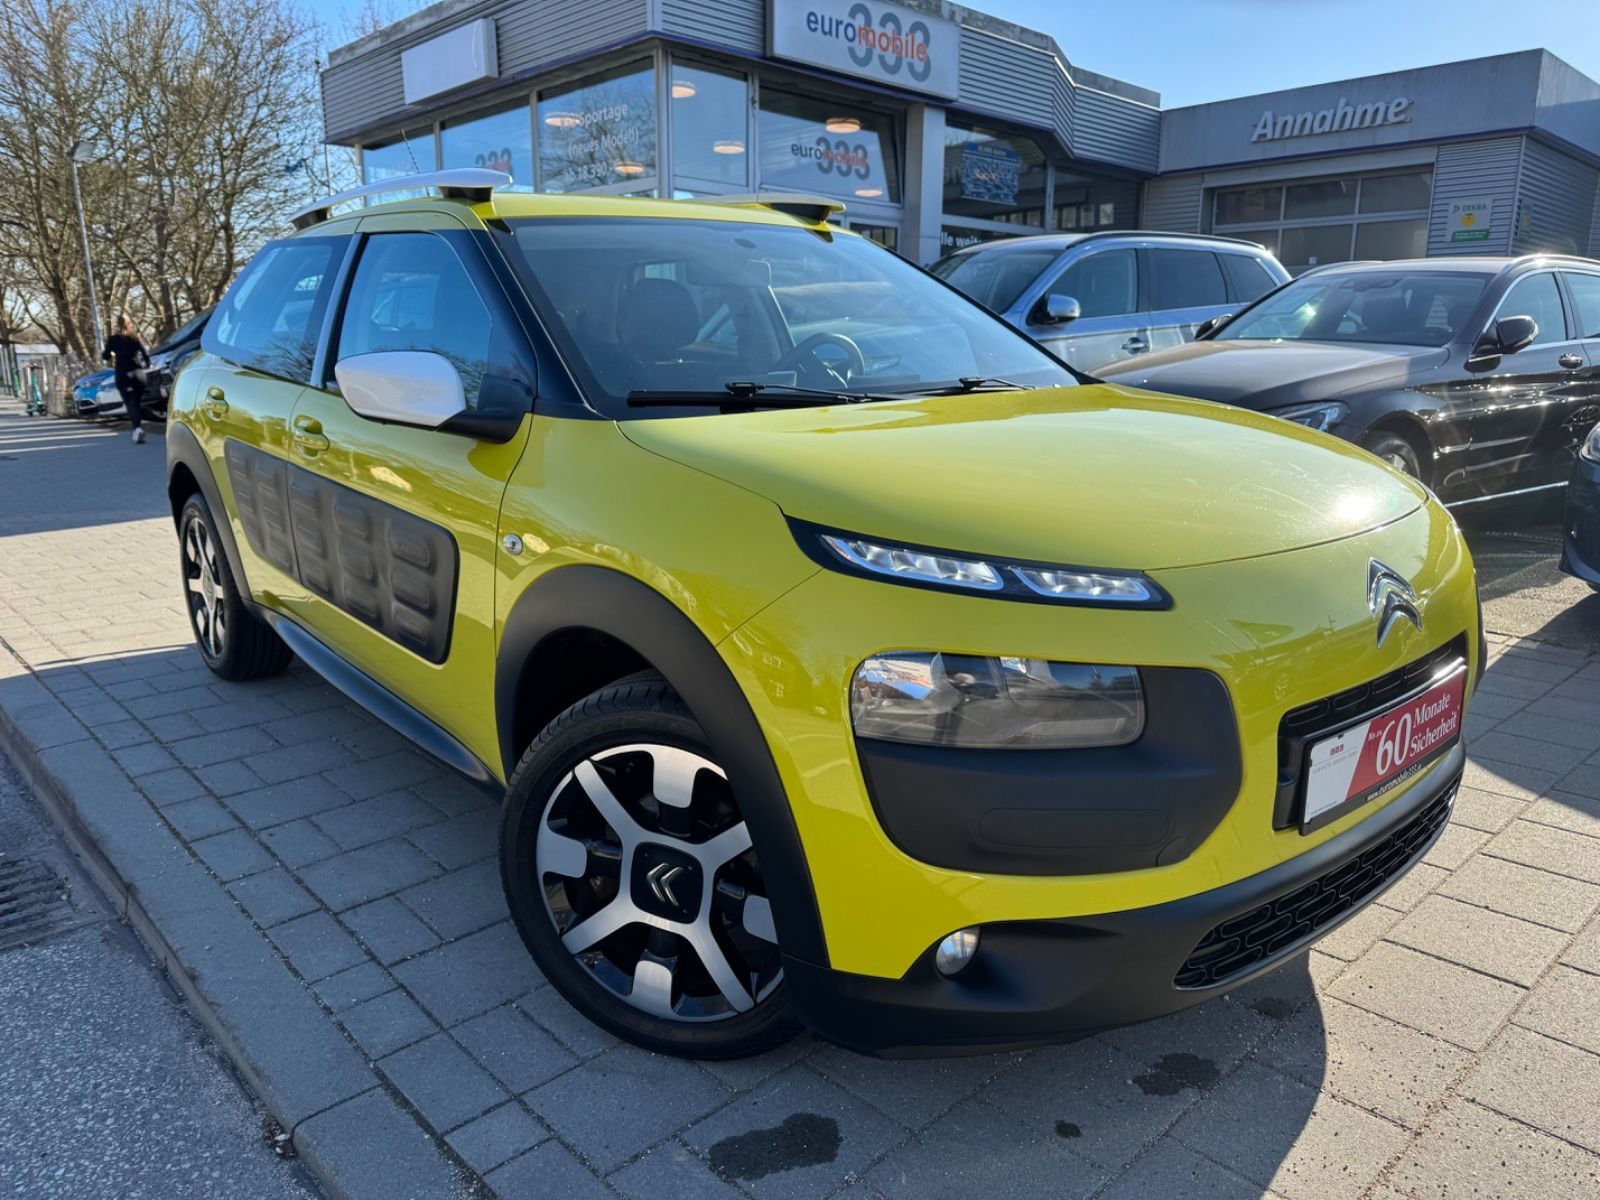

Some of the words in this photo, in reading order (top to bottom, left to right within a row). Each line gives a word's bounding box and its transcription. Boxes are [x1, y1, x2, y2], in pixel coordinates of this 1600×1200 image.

[806, 11, 927, 62] euromobile
[578, 103, 628, 128] Sportage
[1251, 97, 1410, 143] Annahme
[1409, 711, 1457, 757] Sicherheit
[1413, 693, 1451, 729] Monate
[1376, 713, 1412, 776] 60
